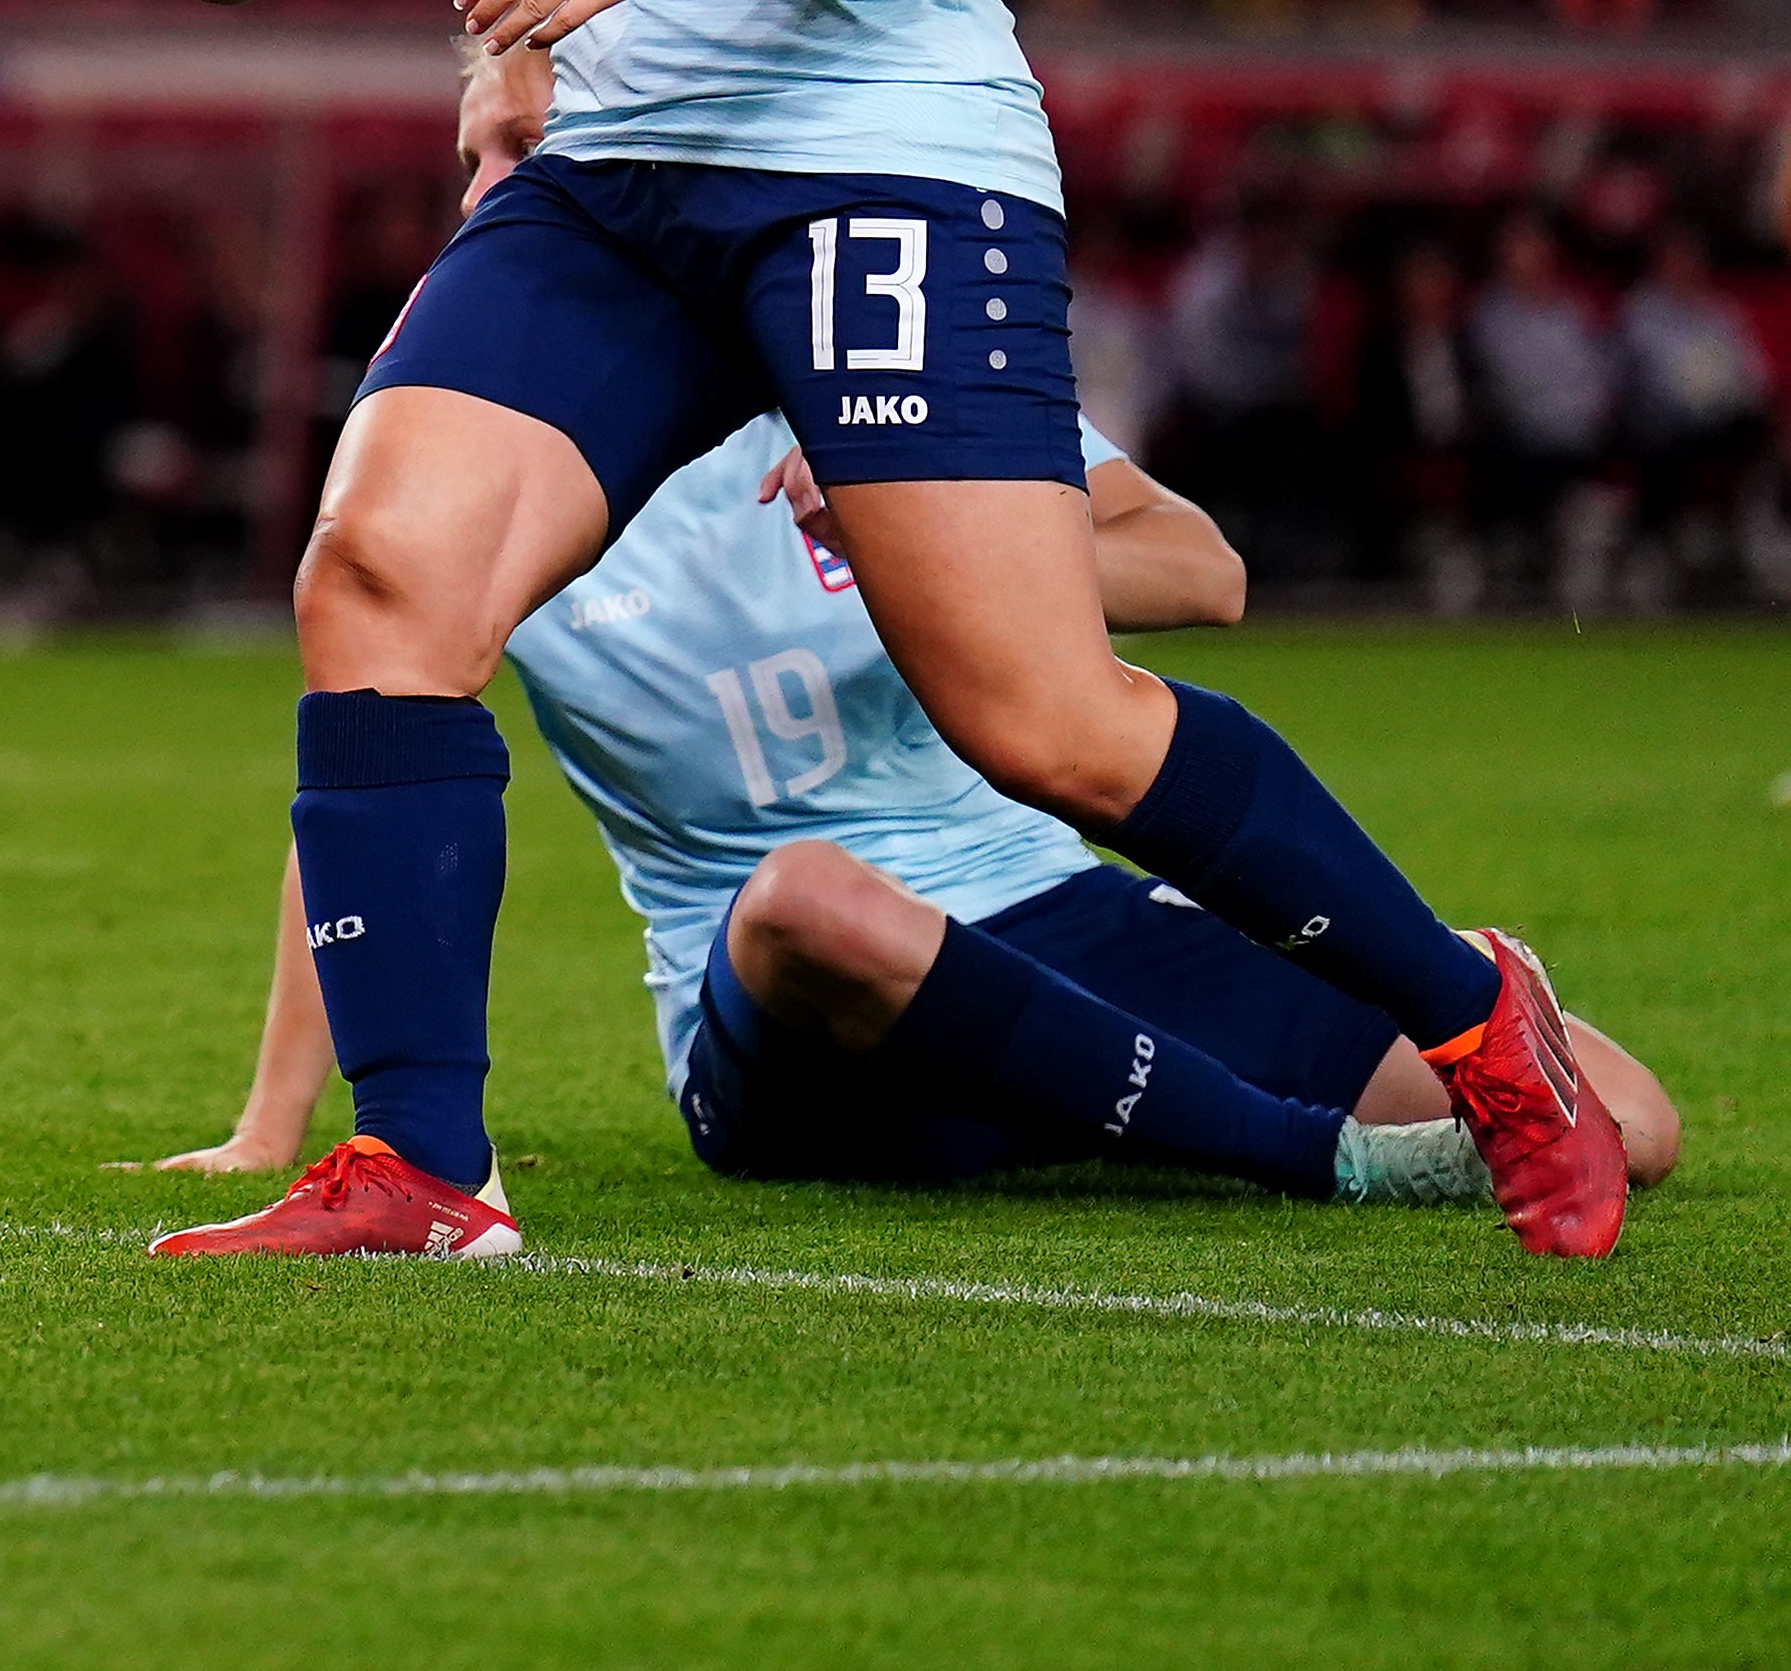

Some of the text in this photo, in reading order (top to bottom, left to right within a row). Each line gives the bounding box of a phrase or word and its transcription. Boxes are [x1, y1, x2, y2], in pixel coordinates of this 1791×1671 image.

[808, 217, 927, 371] 13
[838, 395, 928, 425] JAKO
[570, 588, 651, 630] JAKO
[705, 648, 847, 809] 19
